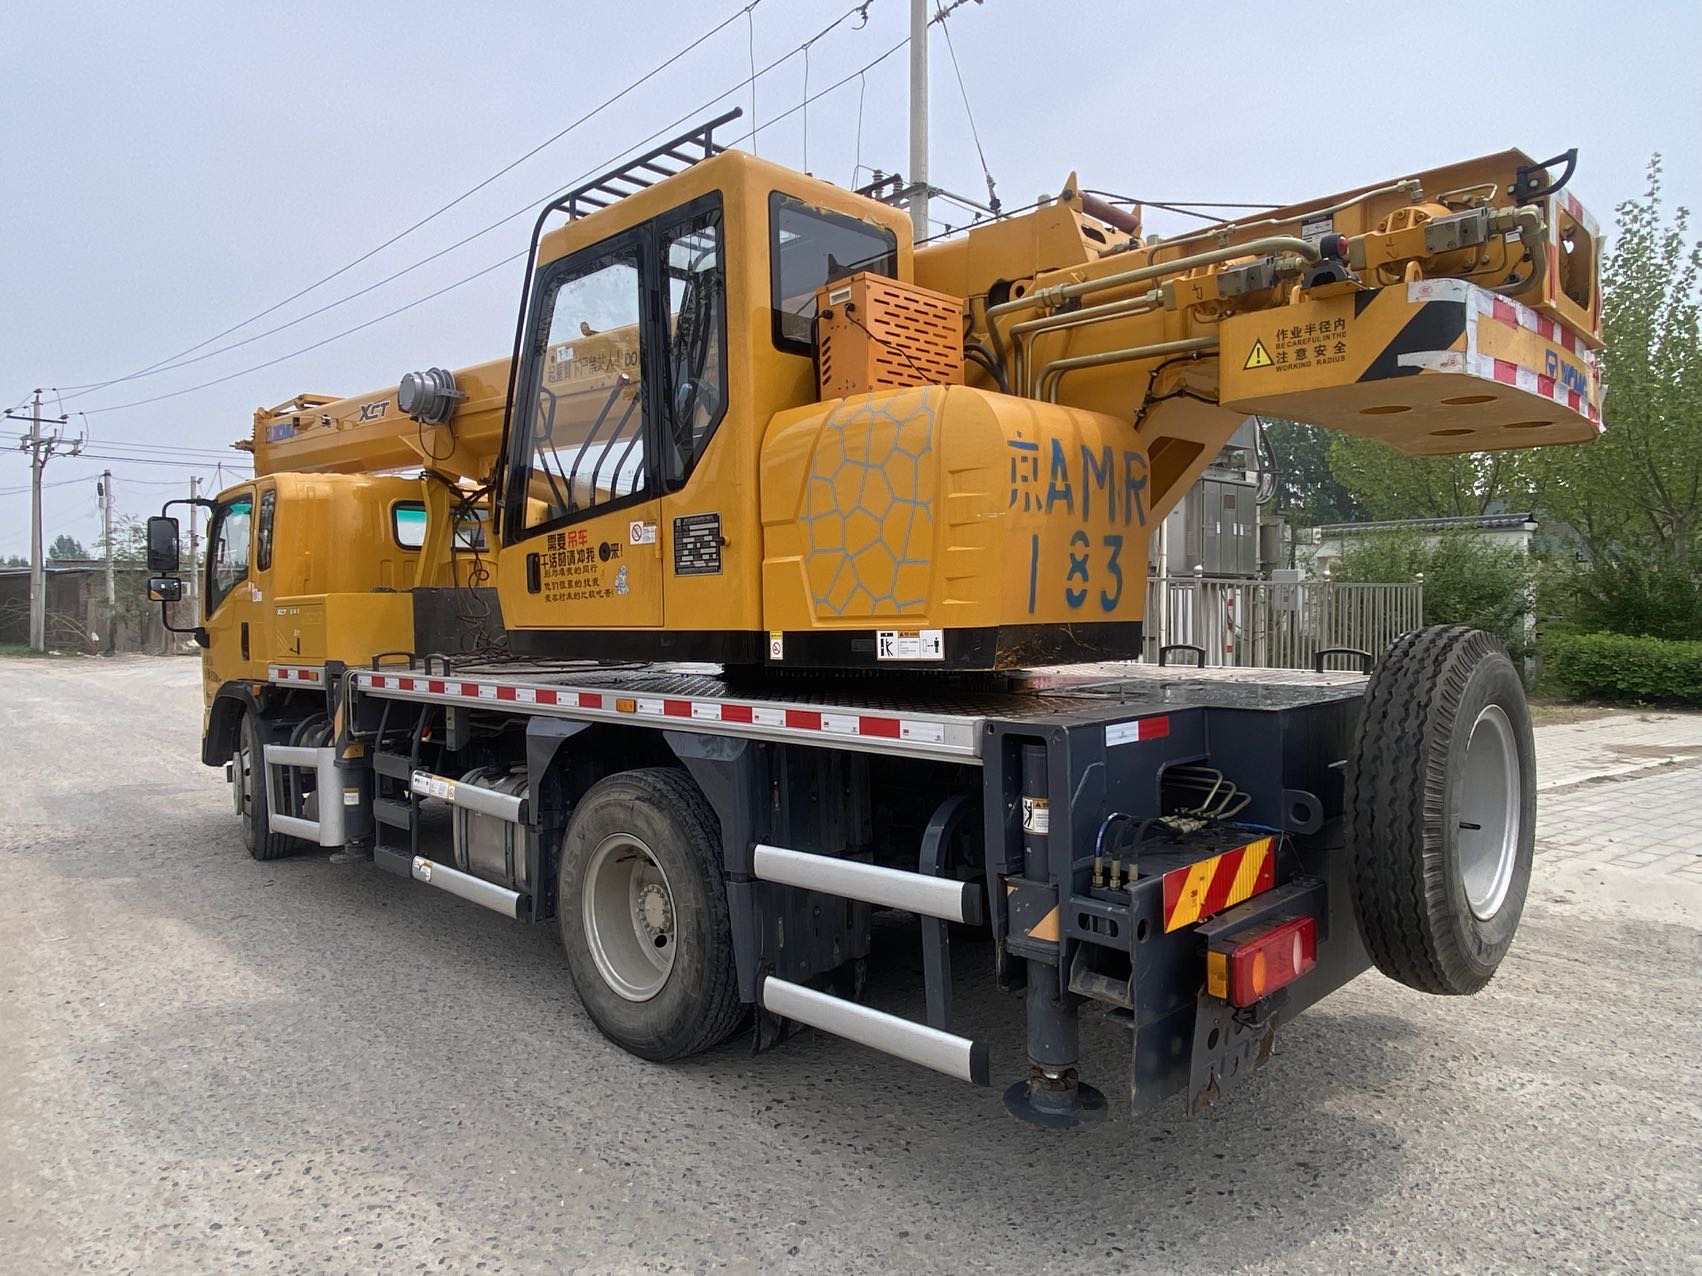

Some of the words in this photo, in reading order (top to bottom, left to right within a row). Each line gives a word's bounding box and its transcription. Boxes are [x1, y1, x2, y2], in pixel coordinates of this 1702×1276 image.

[1276, 318, 1345, 341] 作业半径内
[1276, 341, 1346, 363] 注意安全
[1287, 336, 1321, 347] CAREFUL
[1276, 361, 1312, 372] WORKING
[1316, 355, 1345, 366] RADIUS
[359, 401, 390, 422] XCT
